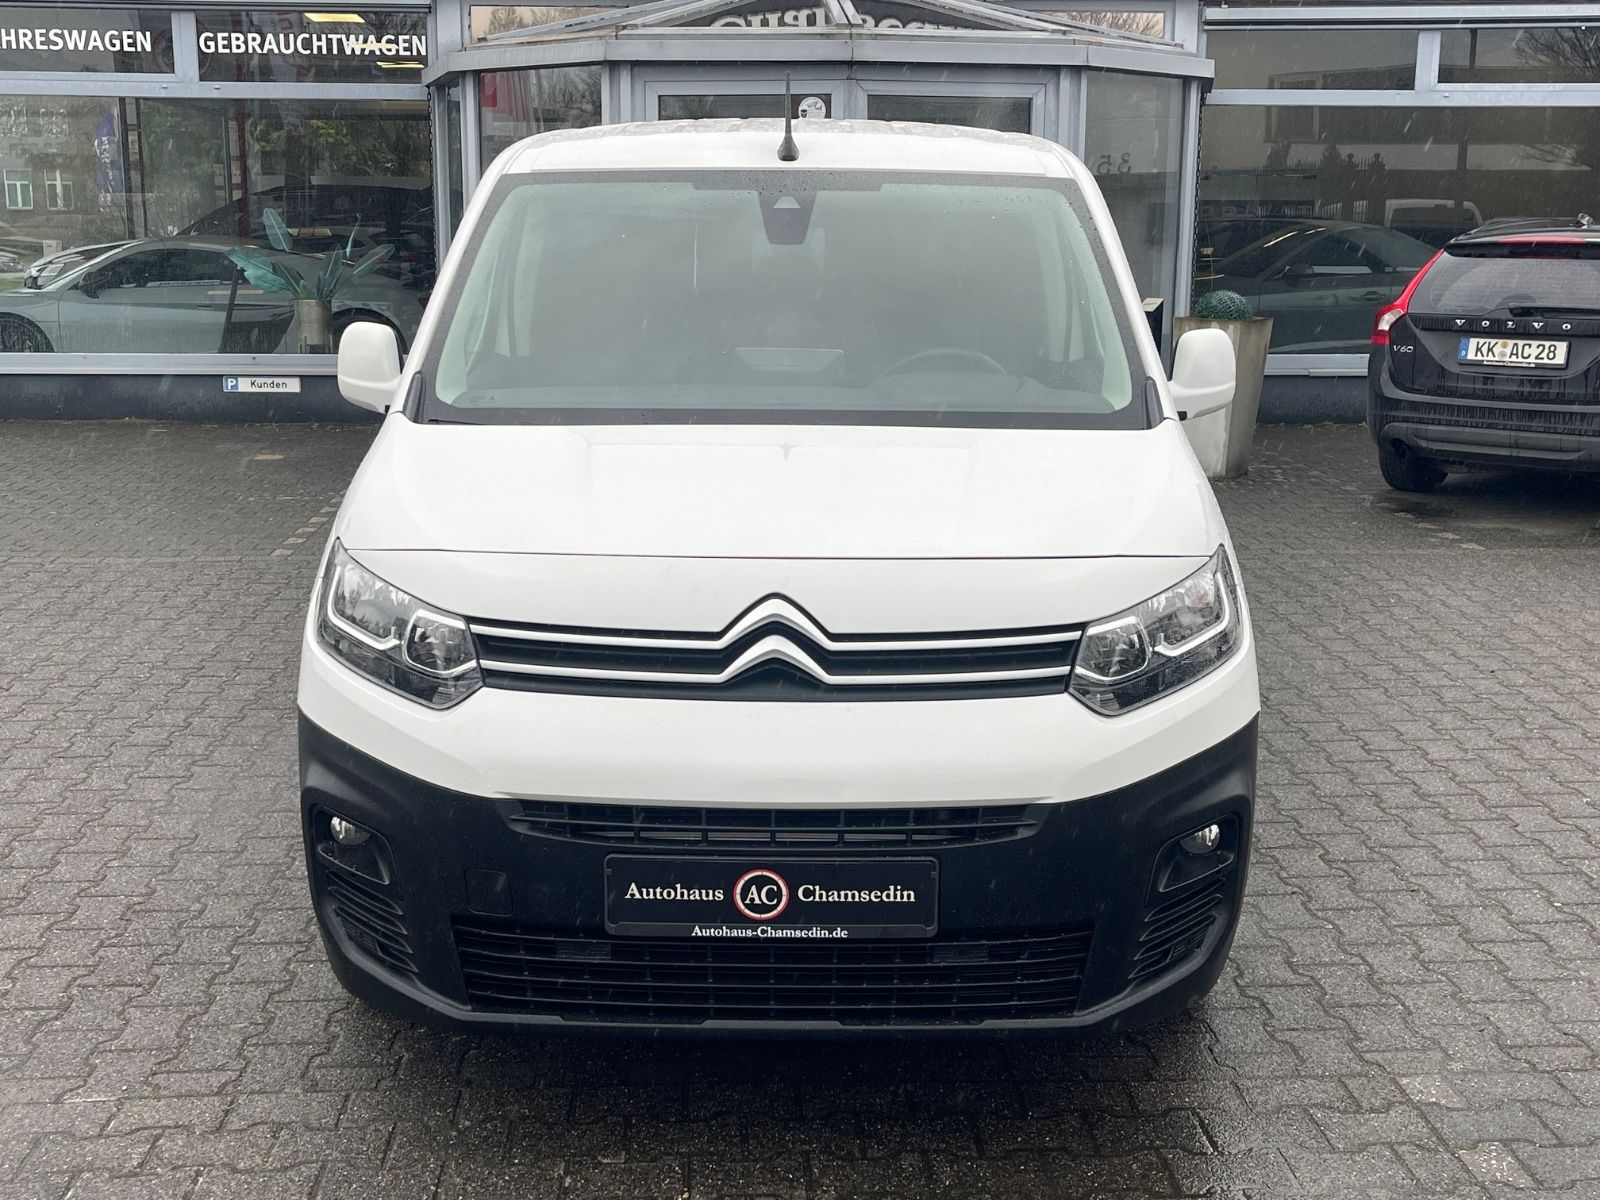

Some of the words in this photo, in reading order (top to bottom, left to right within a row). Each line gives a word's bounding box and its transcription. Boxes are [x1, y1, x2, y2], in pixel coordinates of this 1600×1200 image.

[0, 28, 152, 53] HRESWAGEN
[199, 32, 427, 56] GEBRAUCHTWAGEN
[1455, 319, 1571, 331] VOLVO
[1393, 344, 1414, 353] V60
[1474, 341, 1499, 358] KK
[227, 378, 236, 390] P
[250, 379, 288, 389] Kunden
[624, 882, 724, 901] Autohaus
[744, 884, 778, 905] AC
[797, 884, 916, 903] Chamsedin
[691, 925, 849, 939] Autohaus-Chamsedin.de
